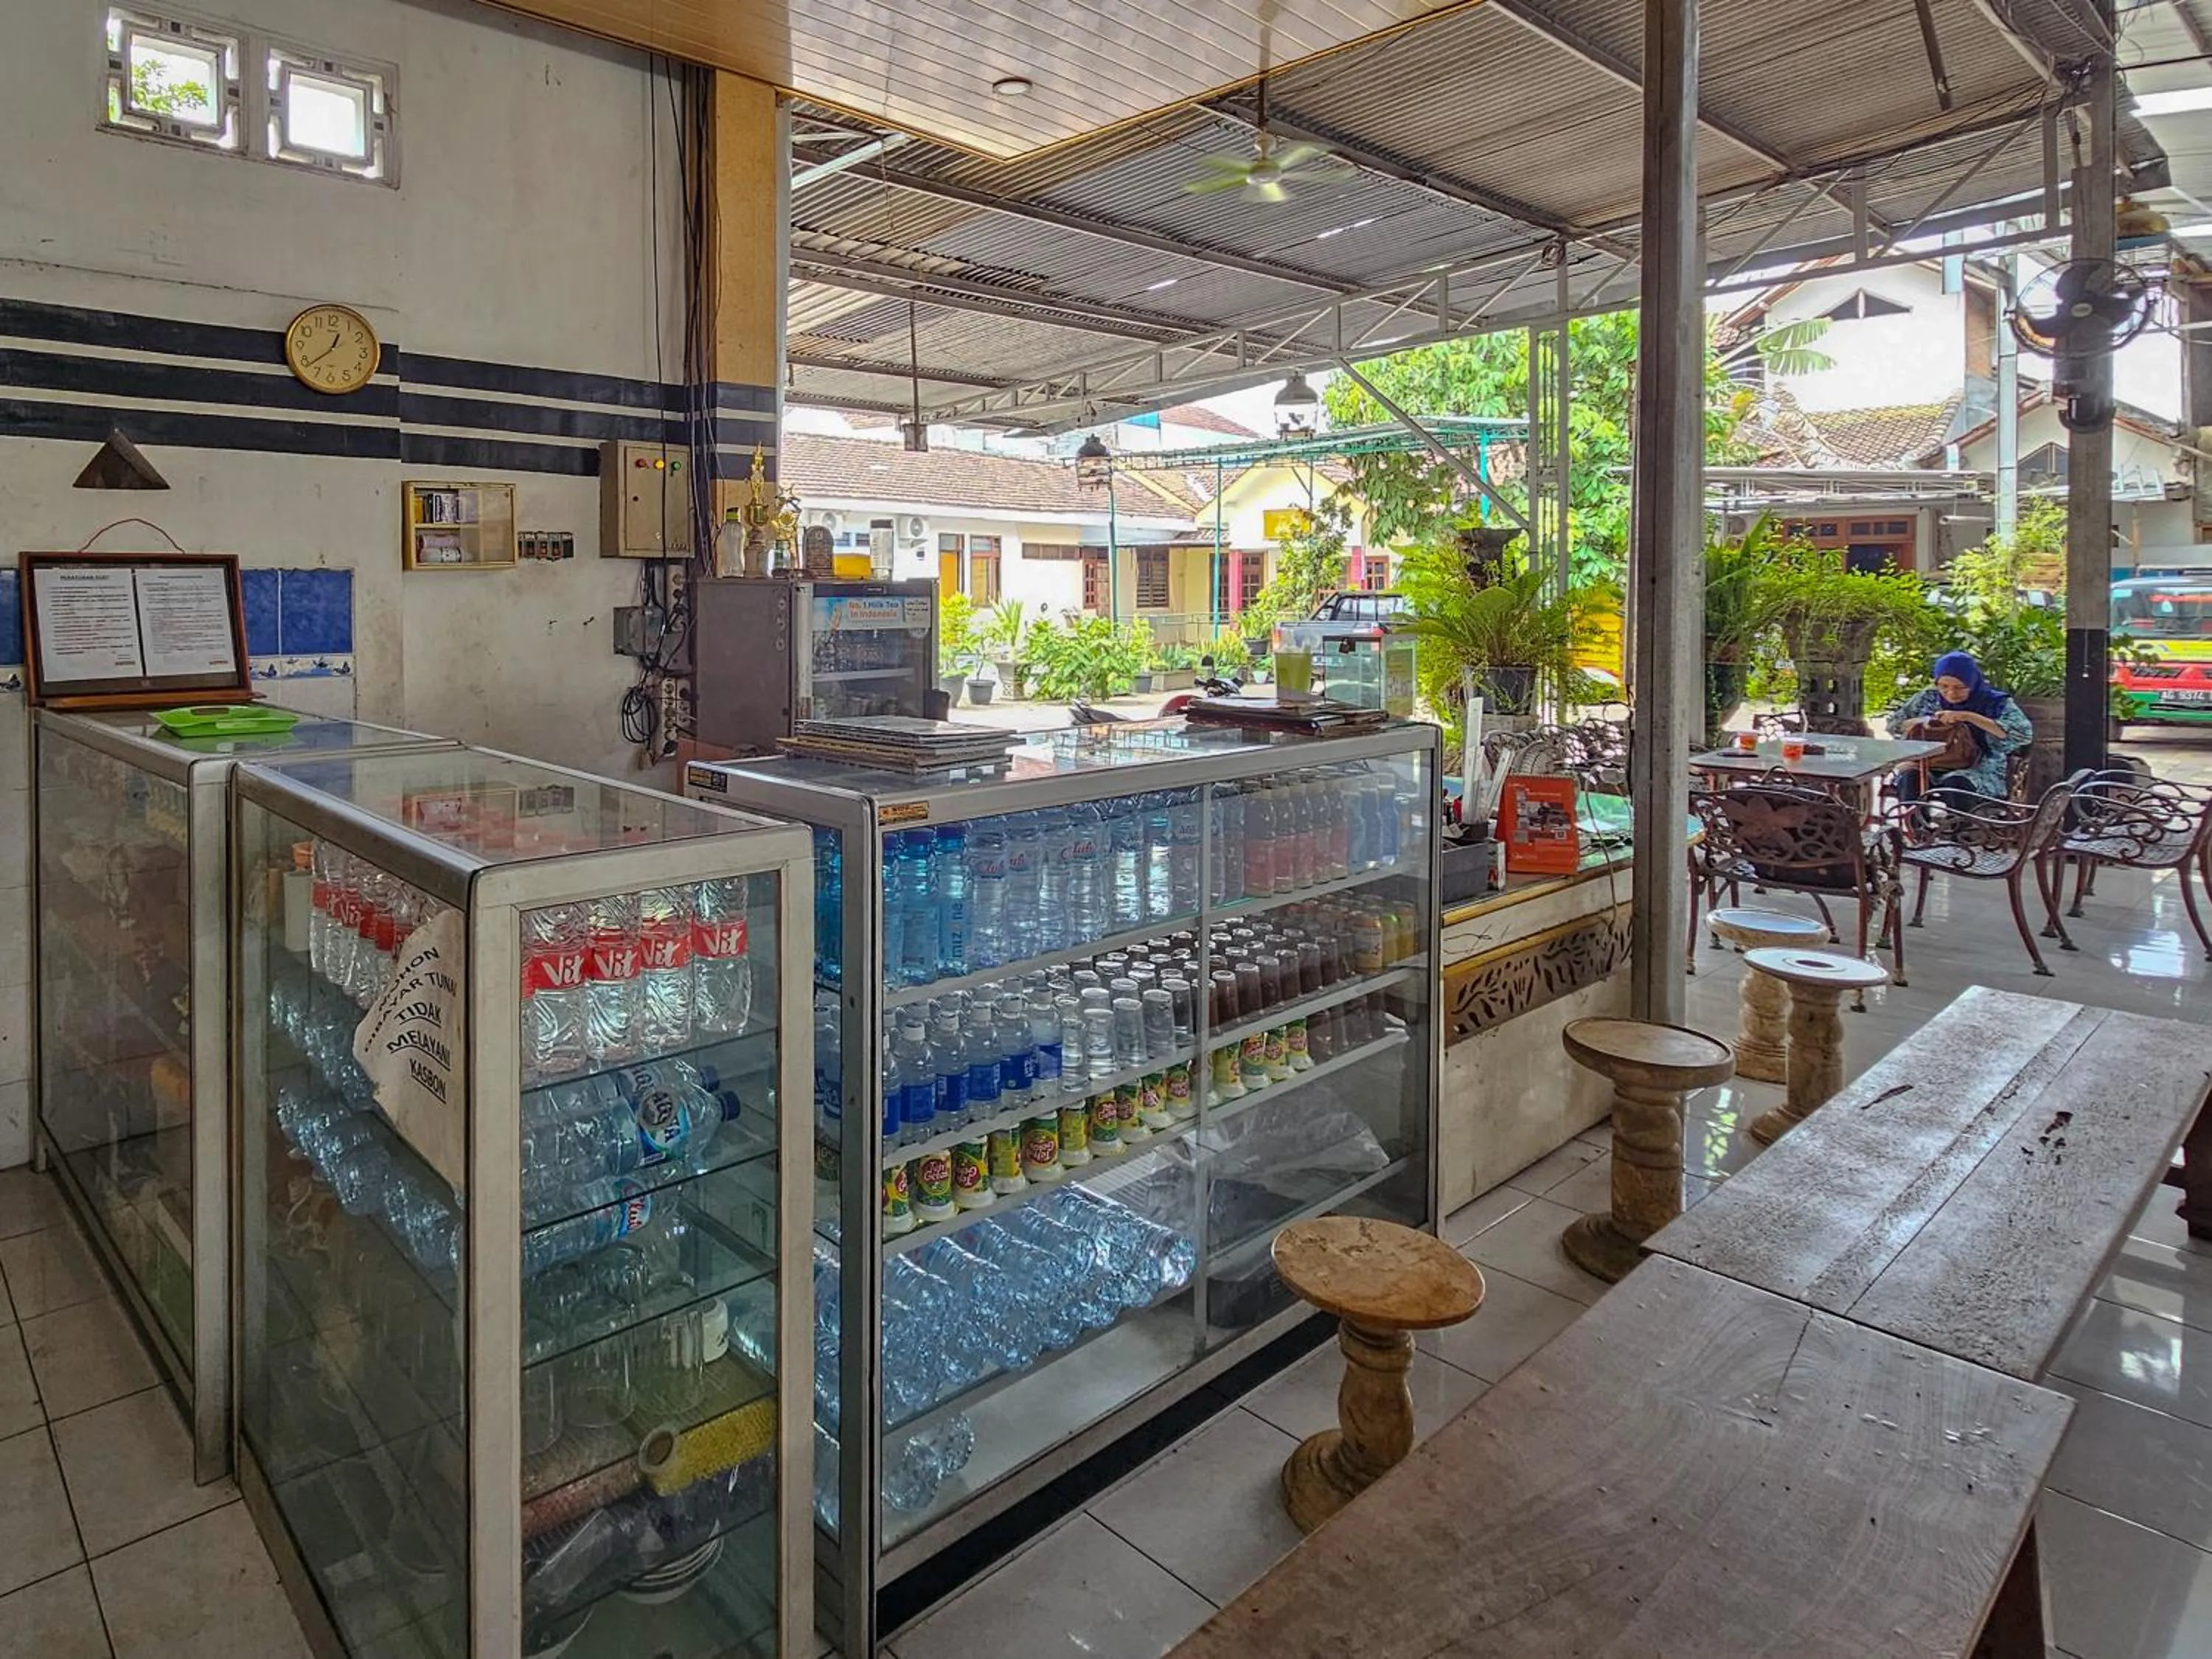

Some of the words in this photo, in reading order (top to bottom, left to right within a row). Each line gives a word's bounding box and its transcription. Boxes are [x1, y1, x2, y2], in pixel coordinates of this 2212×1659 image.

[314, 316, 322, 328] 11
[328, 314, 339, 327] 12
[355, 331, 364, 344] 2
[296, 340, 305, 350] 9
[359, 347, 368, 359] 3
[300, 355, 310, 367] 8
[354, 361, 361, 372] 4
[313, 366, 321, 378] 7
[326, 372, 335, 383] 6
[341, 369, 351, 381] 5
[703, 927, 742, 955] Vit
[641, 938, 681, 968] Vit
[594, 947, 638, 978] Vit
[542, 954, 585, 986] Vit
[394, 1002, 442, 1025] TIDAK
[386, 1029, 451, 1068] MELAYANI
[409, 1057, 447, 1100] KASBON
